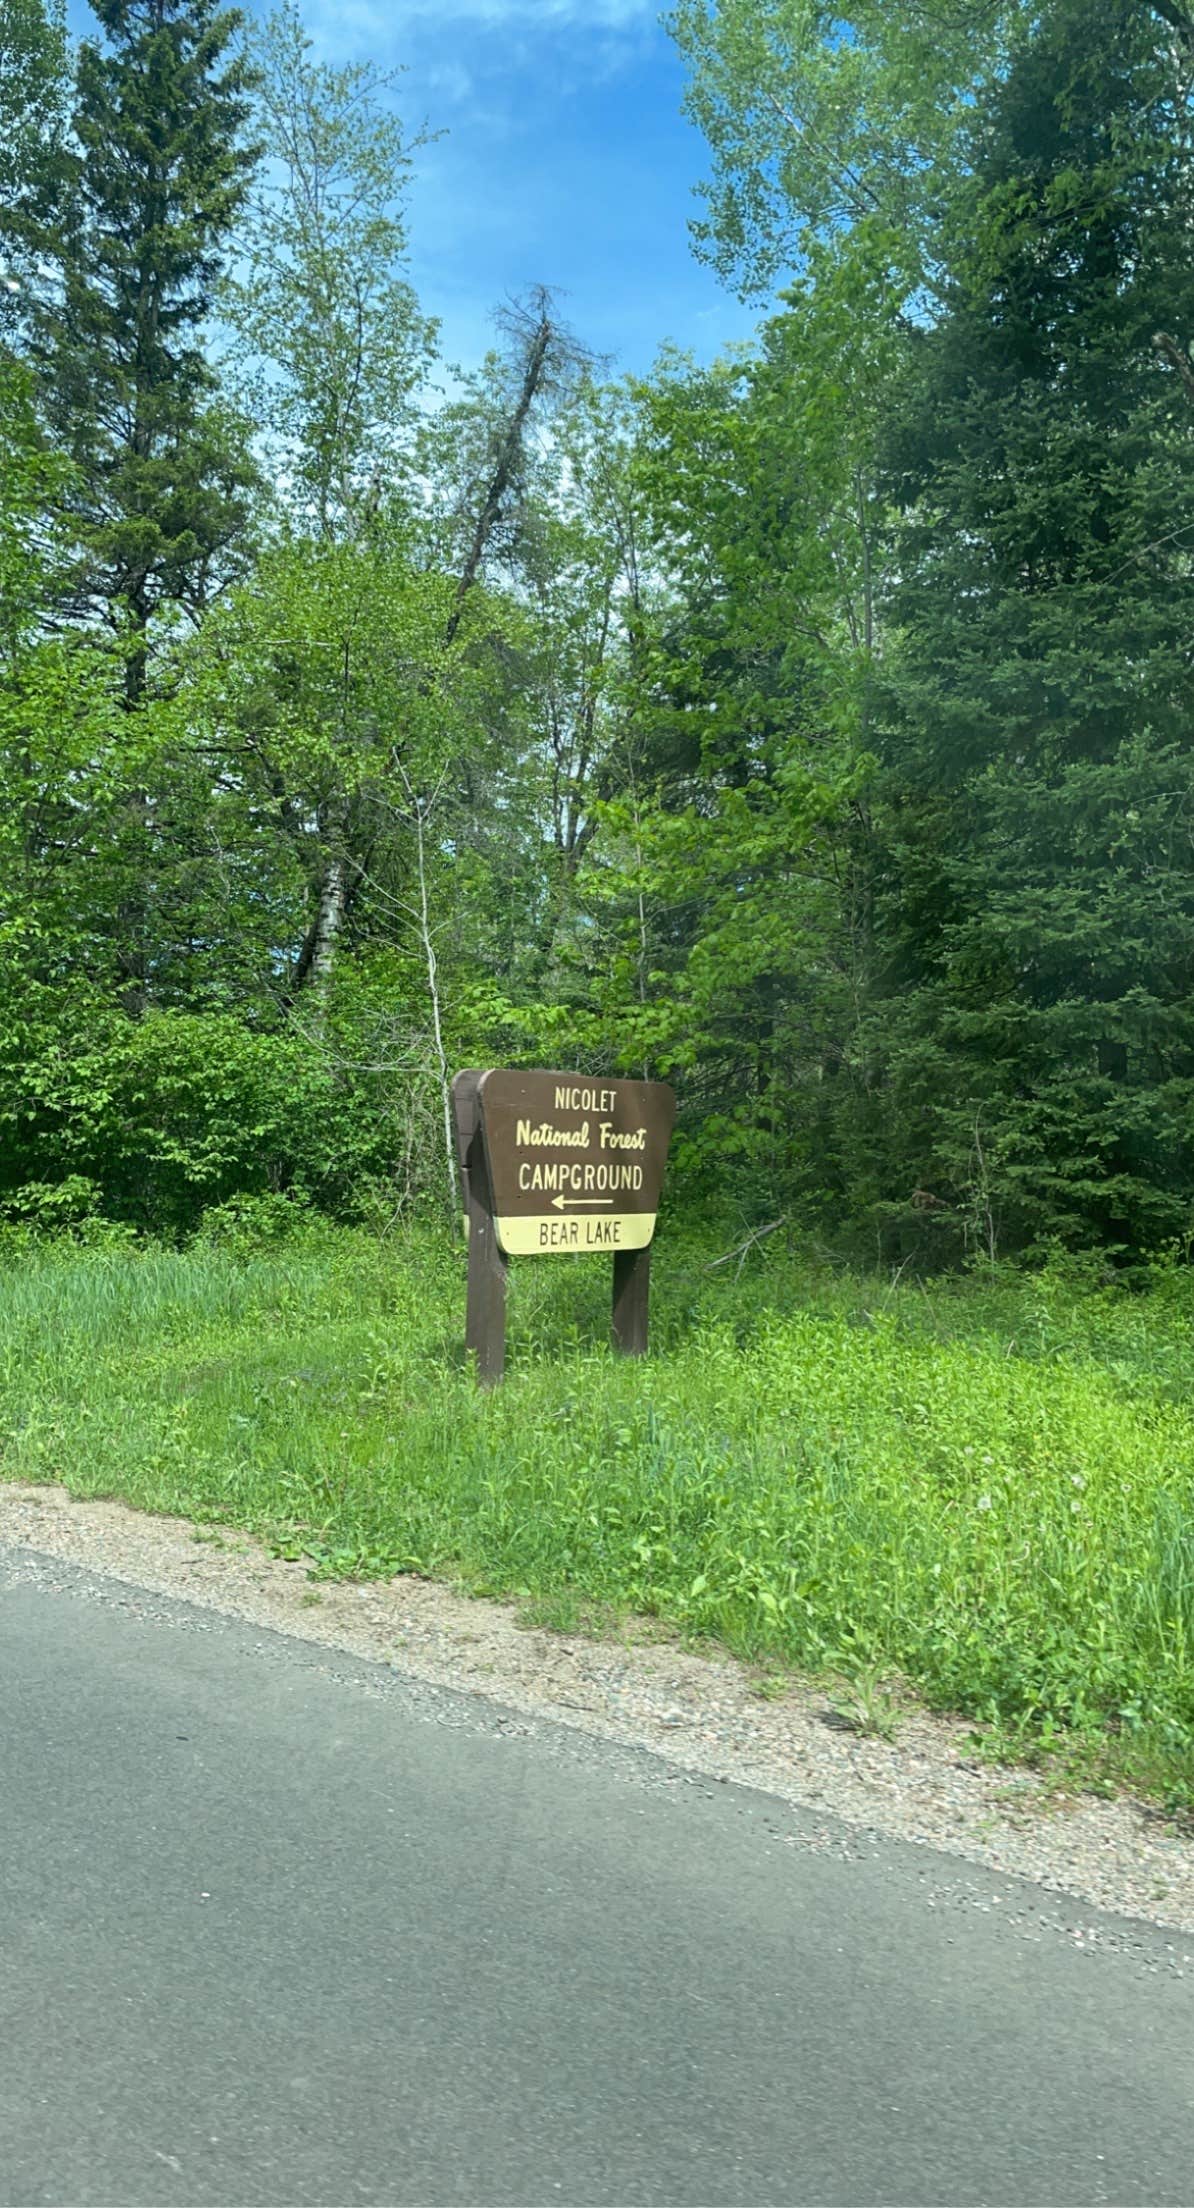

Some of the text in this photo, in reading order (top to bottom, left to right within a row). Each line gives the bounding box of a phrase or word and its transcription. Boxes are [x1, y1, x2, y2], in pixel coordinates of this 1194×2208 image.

[555, 1086, 617, 1112] NICOLET
[516, 1119, 647, 1150] National Forest
[519, 1163, 643, 1190] CAMPGROUND
[539, 1221, 621, 1246] BEAR LAKE
